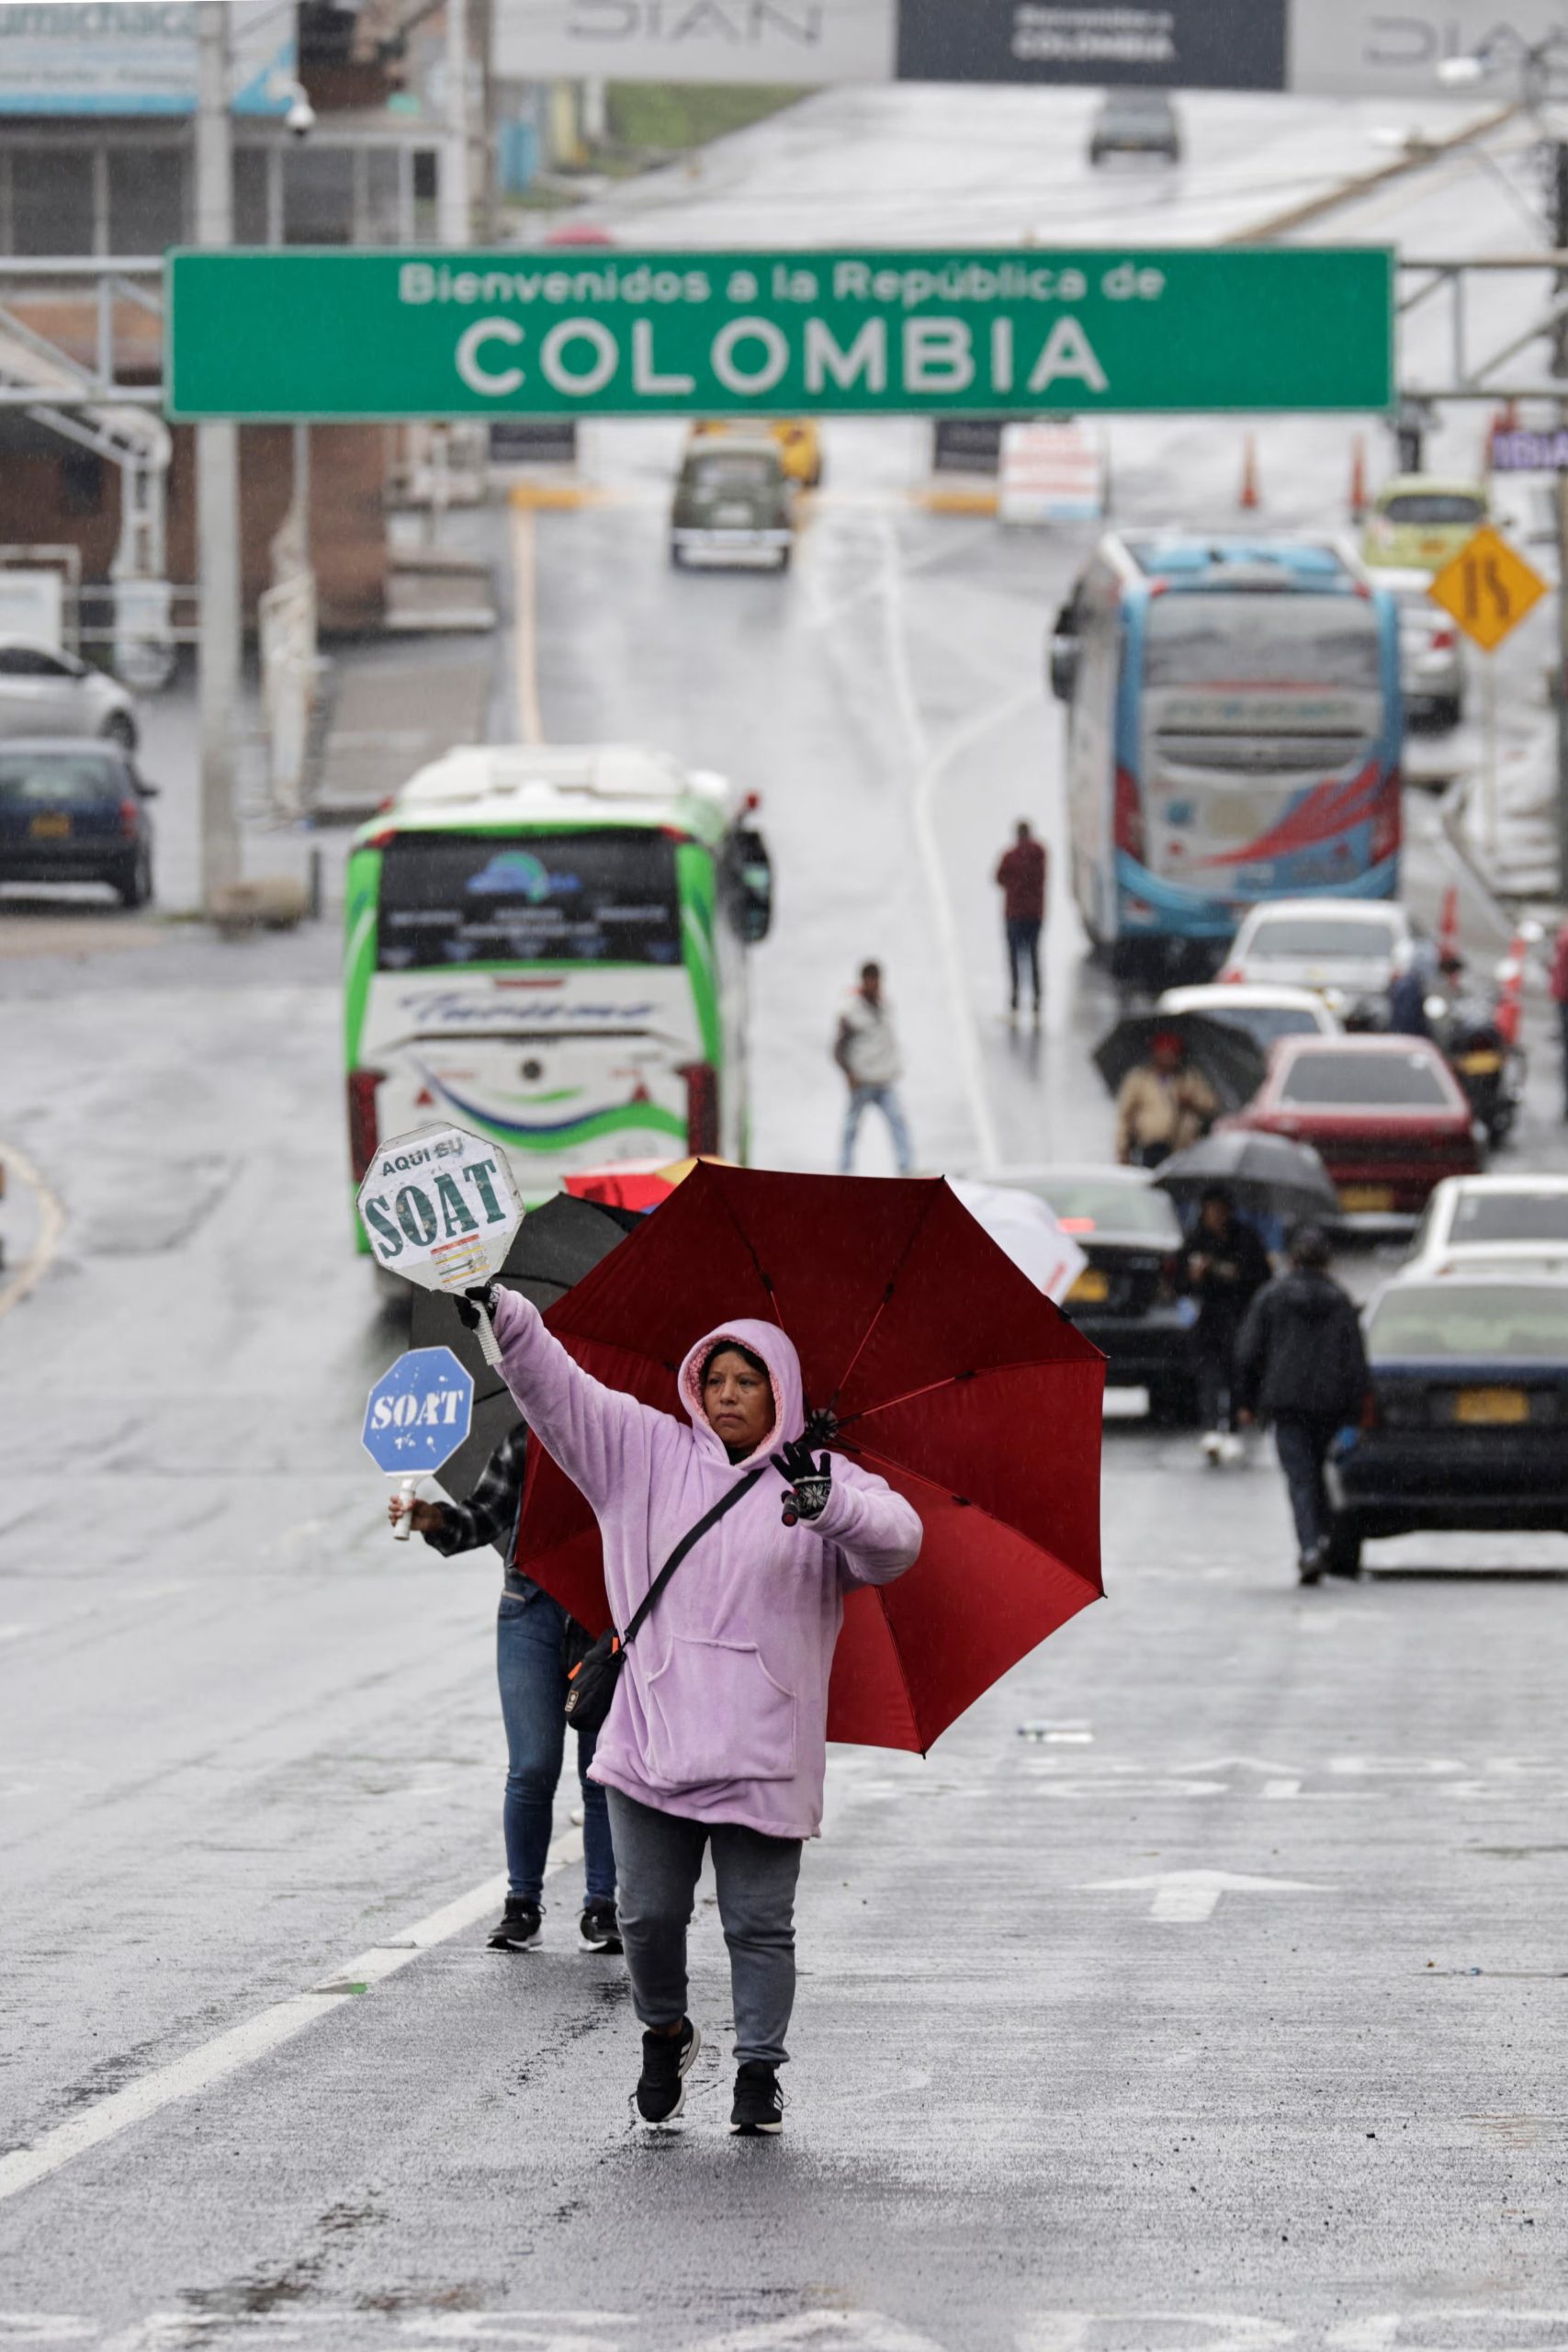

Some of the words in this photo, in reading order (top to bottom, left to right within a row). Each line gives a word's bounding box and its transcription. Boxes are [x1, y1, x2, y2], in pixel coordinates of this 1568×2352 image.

[399, 262, 711, 304] Bienvenidos
[727, 270, 758, 303] a
[773, 263, 818, 303] la
[831, 259, 1088, 308] República
[1101, 262, 1166, 300] de
[455, 315, 1111, 397] COLOMBIA
[382, 1148, 431, 1177] AQUI
[434, 1136, 464, 1159] SU
[365, 1159, 506, 1259] SOAT
[370, 1388, 464, 1430] SOAT
